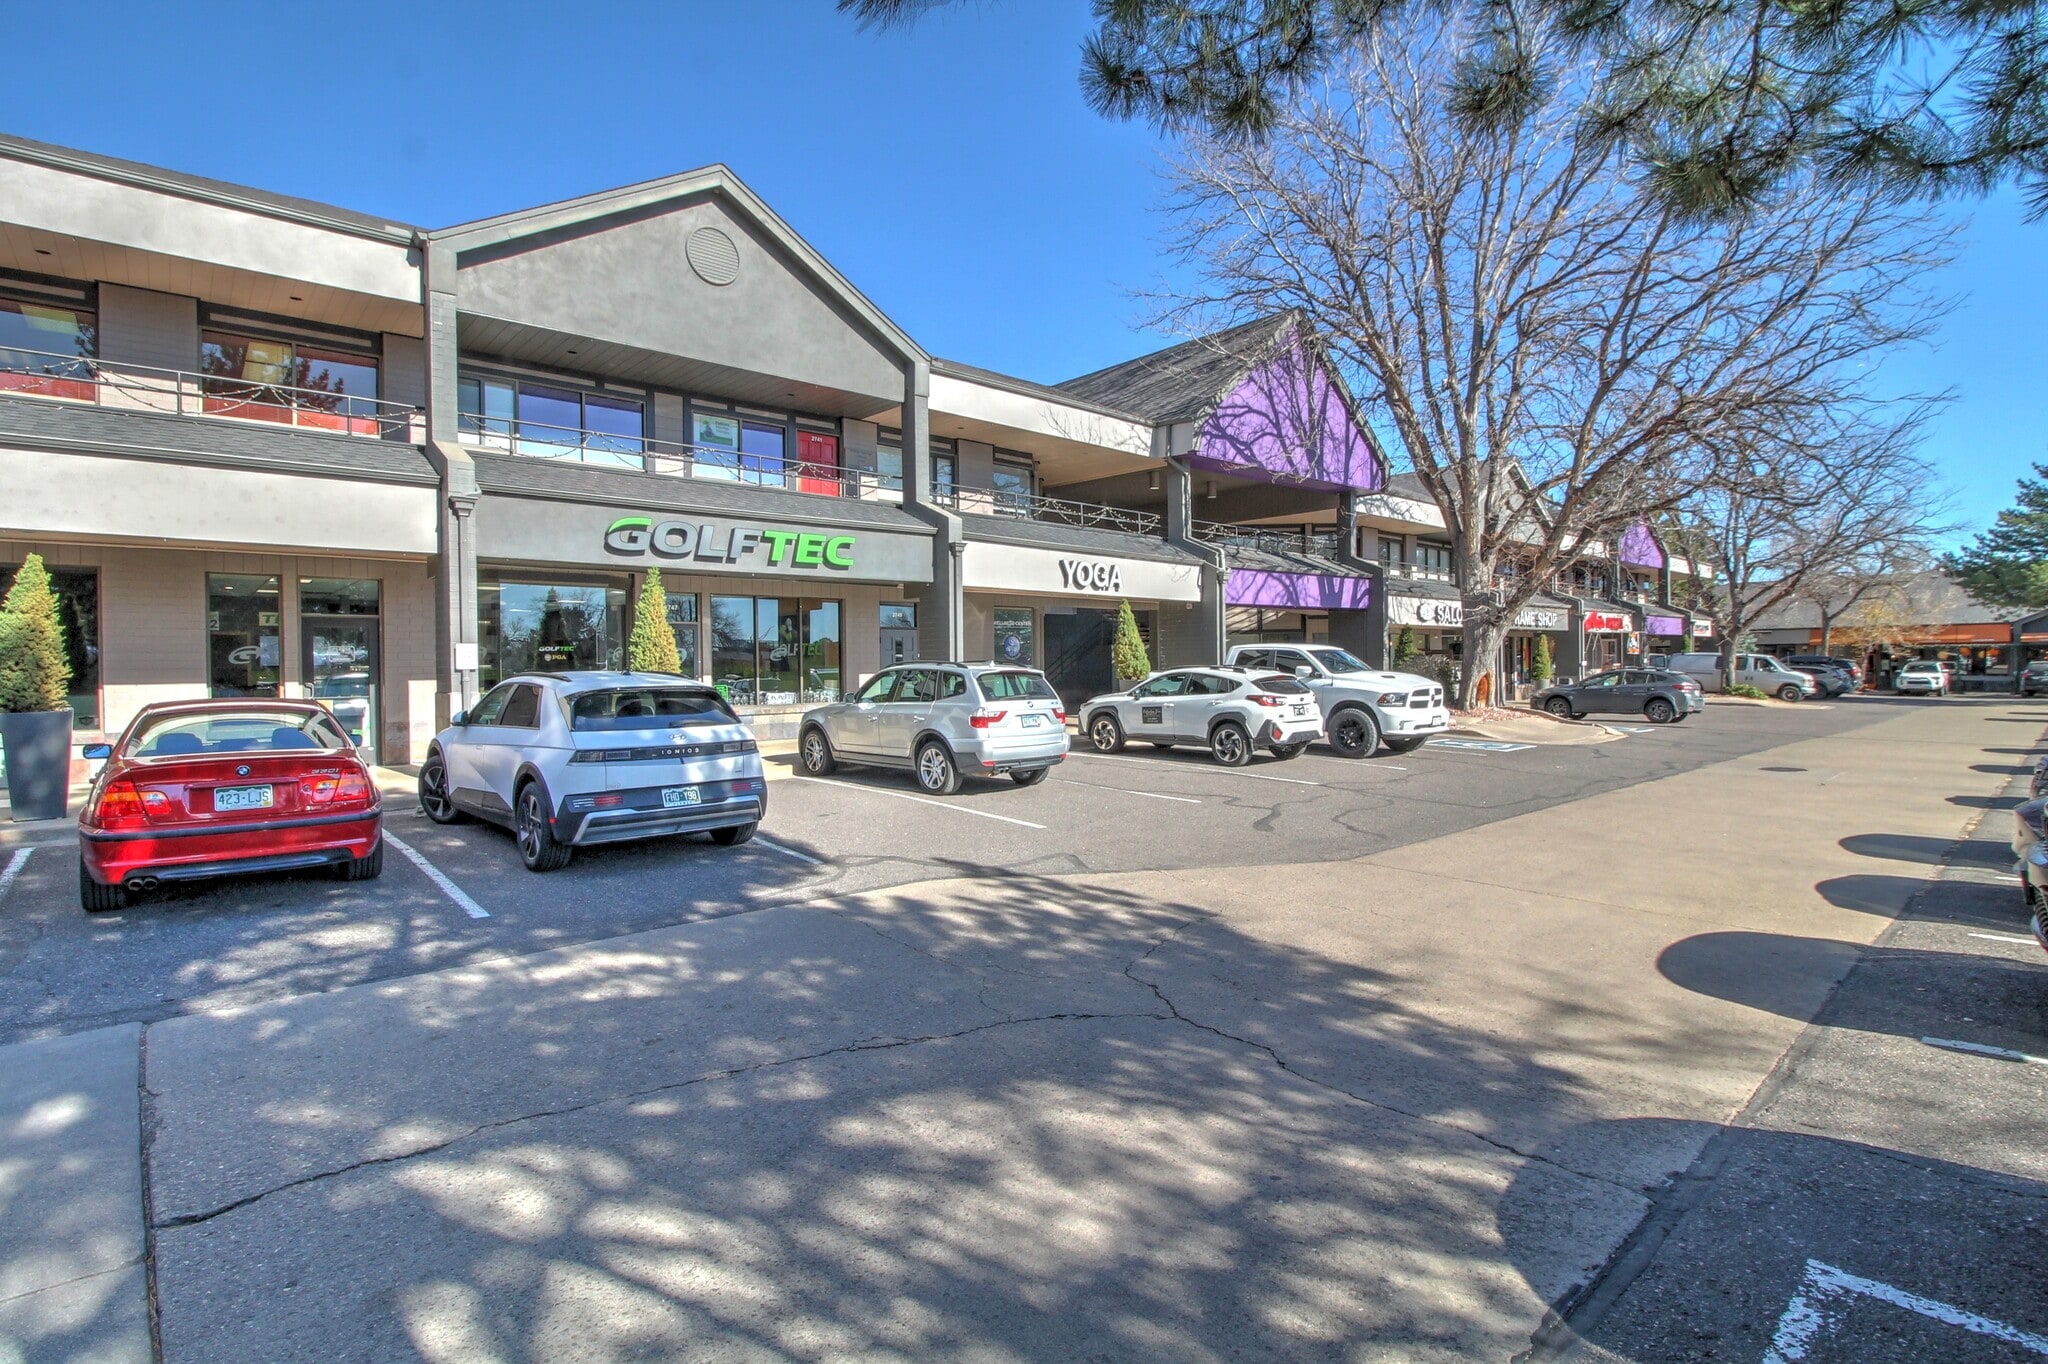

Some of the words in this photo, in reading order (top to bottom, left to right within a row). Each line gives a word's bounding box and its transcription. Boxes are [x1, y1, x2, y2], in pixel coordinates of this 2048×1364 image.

[605, 517, 856, 568] GOLFTEC
[1059, 560, 1123, 590] YOGA
[1437, 606, 1463, 623] SALO
[1514, 610, 1535, 625] RAME
[1538, 611, 1558, 626] SHOP
